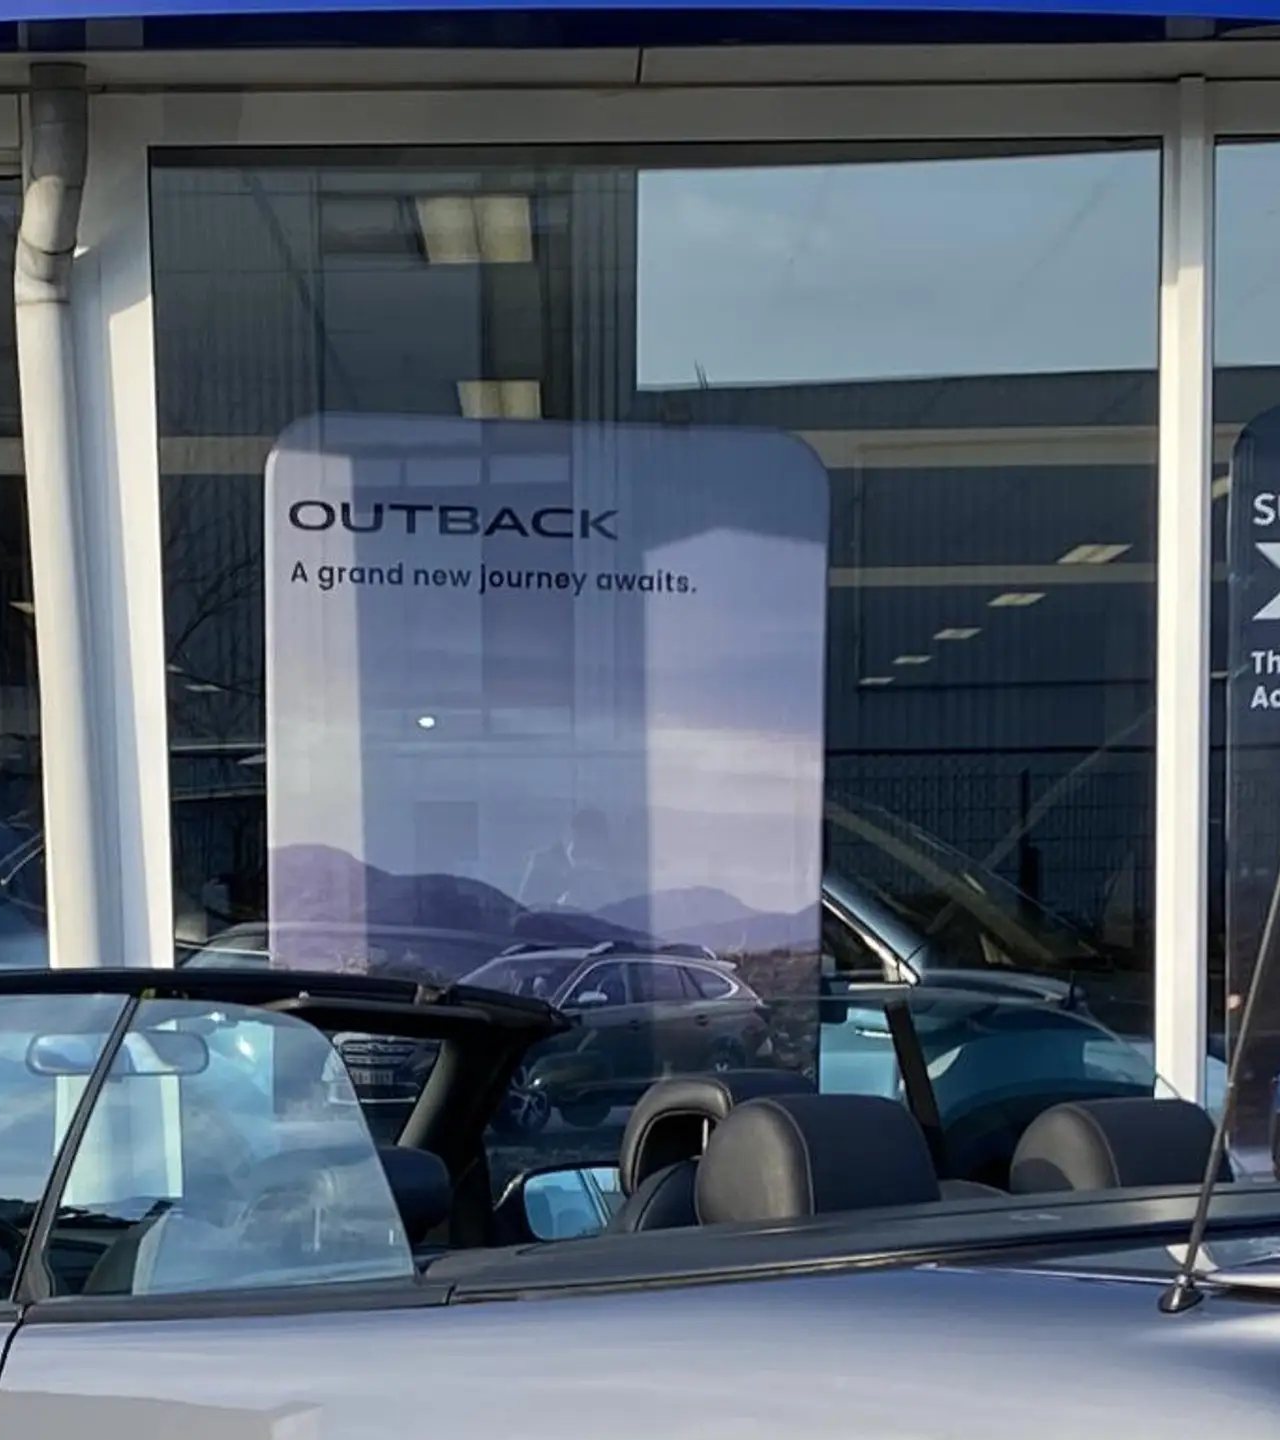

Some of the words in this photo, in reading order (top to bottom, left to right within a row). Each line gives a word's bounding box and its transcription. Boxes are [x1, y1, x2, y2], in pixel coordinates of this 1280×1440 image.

[289, 500, 619, 541] OUTBACK
[290, 562, 308, 583] A
[317, 562, 404, 591] grand
[413, 567, 472, 587] new
[479, 564, 586, 597] journey
[596, 569, 697, 594] awaits.
